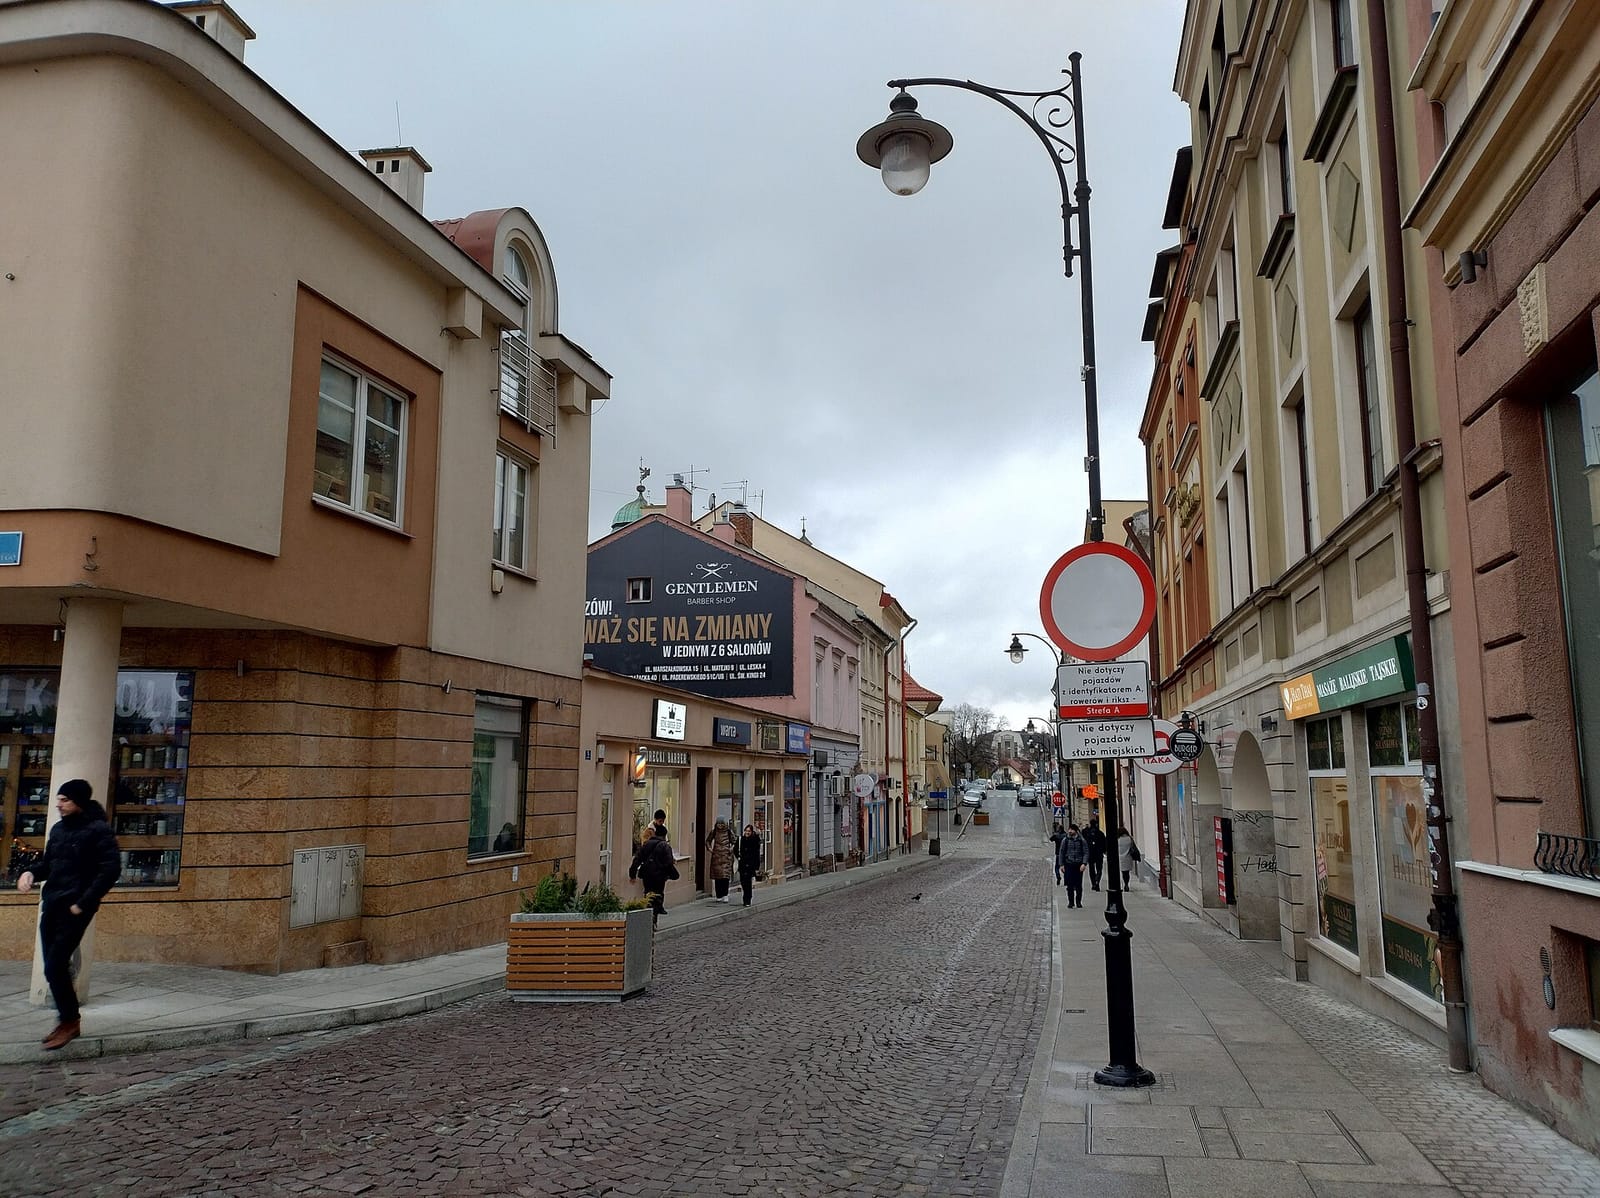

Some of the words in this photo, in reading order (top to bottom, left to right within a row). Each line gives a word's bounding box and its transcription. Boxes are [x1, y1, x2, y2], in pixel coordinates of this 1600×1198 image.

[665, 580, 758, 595] GENTLEMEN
[687, 597, 714, 605] BARBER
[716, 596, 736, 605] SHOP
[627, 616, 657, 646] SIĘ
[663, 616, 690, 641] NA
[694, 613, 773, 640] ZMIANY
[663, 645, 672, 658] W
[673, 645, 709, 658] JEDNYM
[710, 645, 716, 657] Z
[718, 644, 725, 657] 6
[726, 640, 772, 656] SALONÓW
[1078, 667, 1092, 675] Nie
[1094, 667, 1125, 675] dotyczy
[1083, 676, 1121, 686] pojazdów
[1069, 686, 1132, 696] identyfikatorem
[1070, 697, 1103, 705] rowerów
[1086, 706, 1111, 715] Strefa
[1112, 706, 1120, 714] A
[1078, 724, 1094, 732] Nie
[1098, 723, 1135, 733] dotyczy
[1084, 735, 1131, 746] pojazdów
[1072, 748, 1097, 757] służb
[1100, 745, 1146, 756] miejskich
[1174, 743, 1198, 753] BURGER
[1142, 757, 1172, 765] ITAKA
